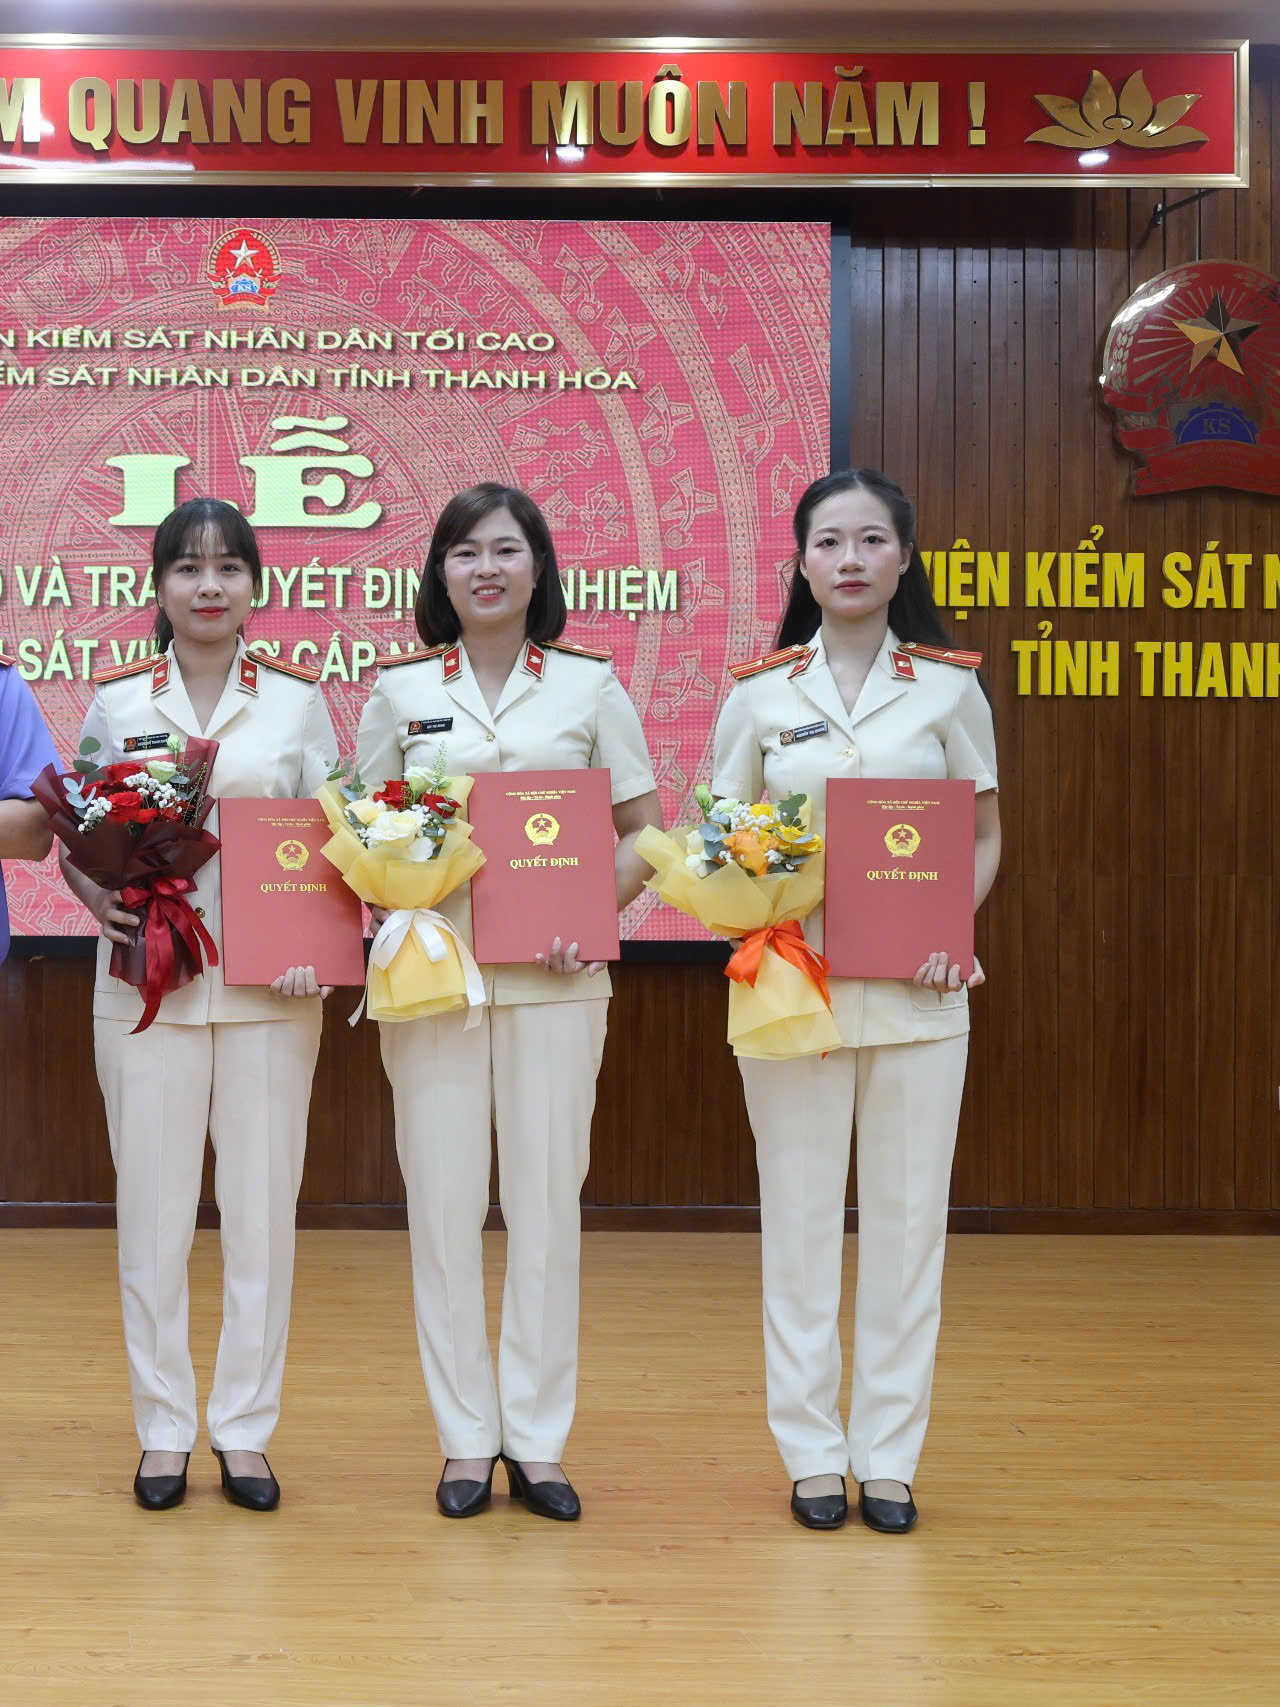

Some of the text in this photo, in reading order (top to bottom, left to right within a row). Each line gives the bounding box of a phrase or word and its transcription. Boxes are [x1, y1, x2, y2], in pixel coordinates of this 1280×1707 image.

[68, 76, 311, 151] QUANG
[335, 79, 504, 144] VINH
[531, 63, 748, 146] MUÔN
[772, 65, 940, 147] NĂM
[967, 81, 986, 146] !
[124, 325, 194, 349] SÁT
[204, 327, 306, 350] NHÂN
[317, 327, 393, 351] DÂN
[406, 326, 465, 351] TỐI
[477, 331, 555, 352] CAO
[47, 362, 118, 386] SÁT
[128, 363, 230, 387] NHÂN
[241, 364, 316, 388] DÂN
[421, 369, 546, 389] THANH
[559, 365, 638, 390] HÓA
[1202, 418, 1231, 434] KS
[1025, 524, 1145, 608] KIỂM
[1161, 540, 1252, 609] SÁT
[15, 556, 72, 607] VÀ
[83, 566, 156, 607] TRA
[250, 557, 353, 609] UYẾT
[18, 630, 99, 681] SÁT
[1011, 620, 1120, 696] TỈNH
[510, 855, 579, 869] QUYẾT ĐỊNH
[866, 867, 939, 882] QUYẾT ĐỊNH
[260, 880, 328, 894] QUYẾT ĐỊNH
